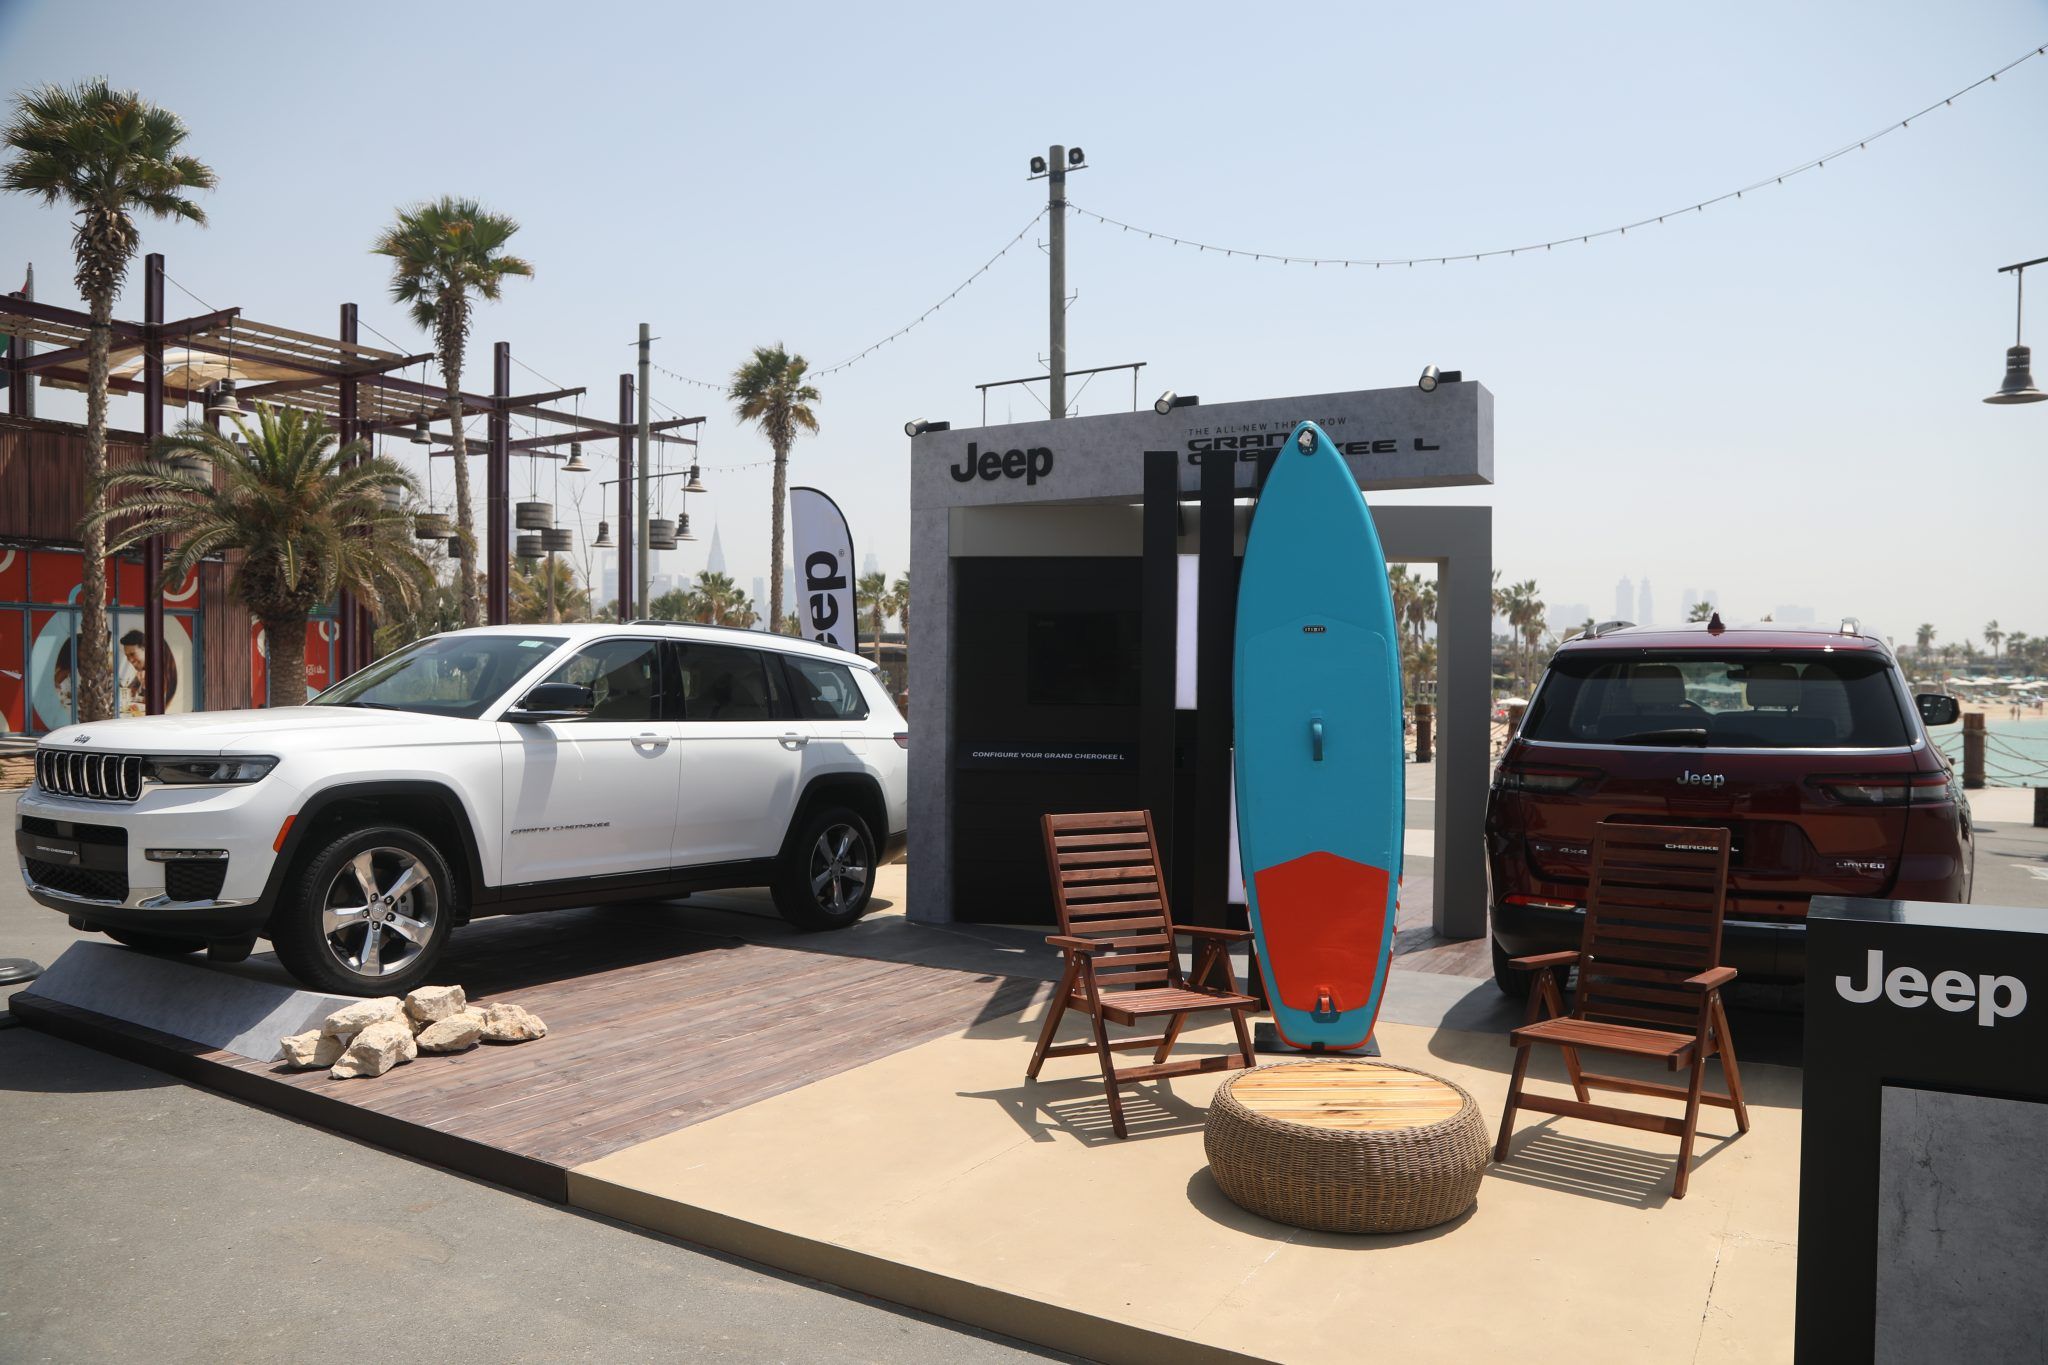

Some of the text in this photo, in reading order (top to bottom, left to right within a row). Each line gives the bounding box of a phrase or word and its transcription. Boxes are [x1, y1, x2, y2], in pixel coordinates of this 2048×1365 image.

[1188, 417, 1347, 436] THE ALL-NEW THRROW
[1187, 432, 1290, 450] GRAN
[1414, 438, 1440, 451] L
[951, 442, 1054, 486] Jeep
[1676, 770, 1725, 789] Jeep
[1664, 843, 1719, 851] CHEROKE
[1835, 949, 2028, 1027] Jeep
